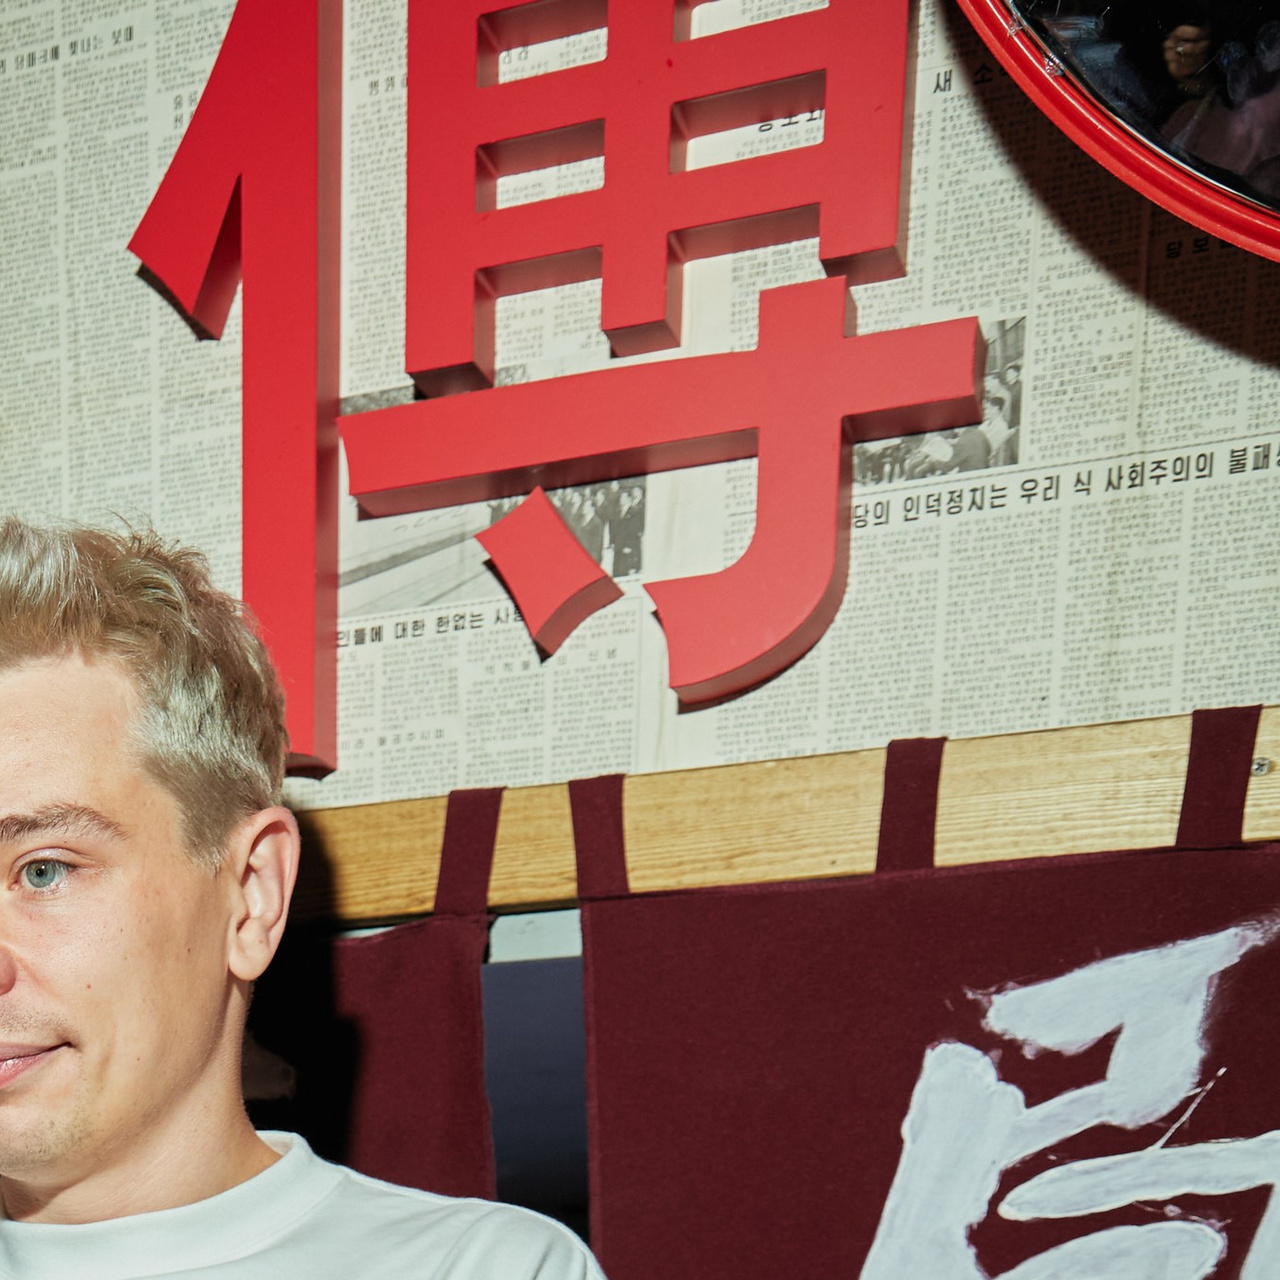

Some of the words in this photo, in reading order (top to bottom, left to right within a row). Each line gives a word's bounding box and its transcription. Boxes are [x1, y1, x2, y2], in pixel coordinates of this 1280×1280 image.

[933, 69, 953, 94] 새
[903, 483, 1009, 523] 인덕정치는
[1019, 475, 1061, 505] 우리
[1072, 468, 1093, 496] 식
[1104, 451, 1215, 491] 사회주의의
[394, 618, 426, 640] 대한
[436, 610, 486, 635] 한없는
